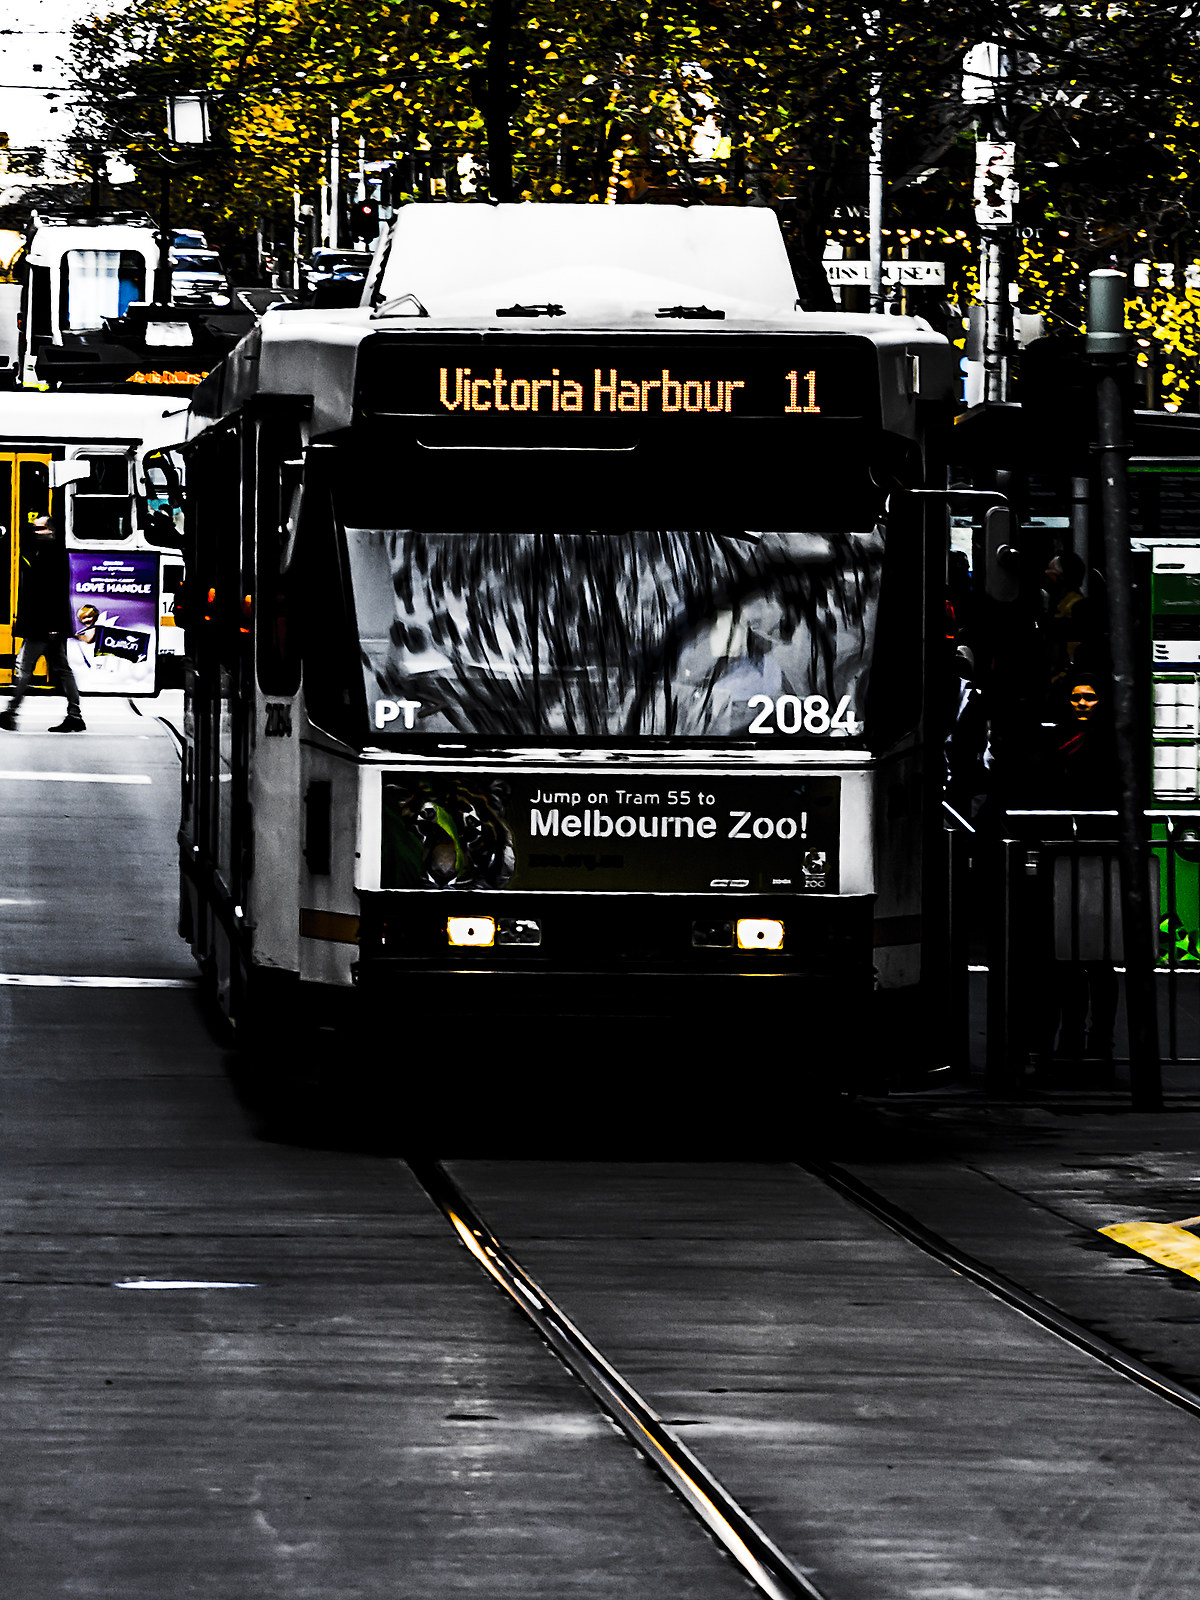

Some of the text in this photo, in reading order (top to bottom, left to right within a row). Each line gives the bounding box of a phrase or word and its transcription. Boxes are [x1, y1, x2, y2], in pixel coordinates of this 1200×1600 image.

[440, 367, 821, 413] Victoria Harbour 11
[75, 582, 152, 594] LOVE HANDLE
[747, 694, 860, 735] 2084
[529, 789, 716, 807] Jump on Tram 55 to
[530, 808, 809, 840] Melbourne Zoo!
